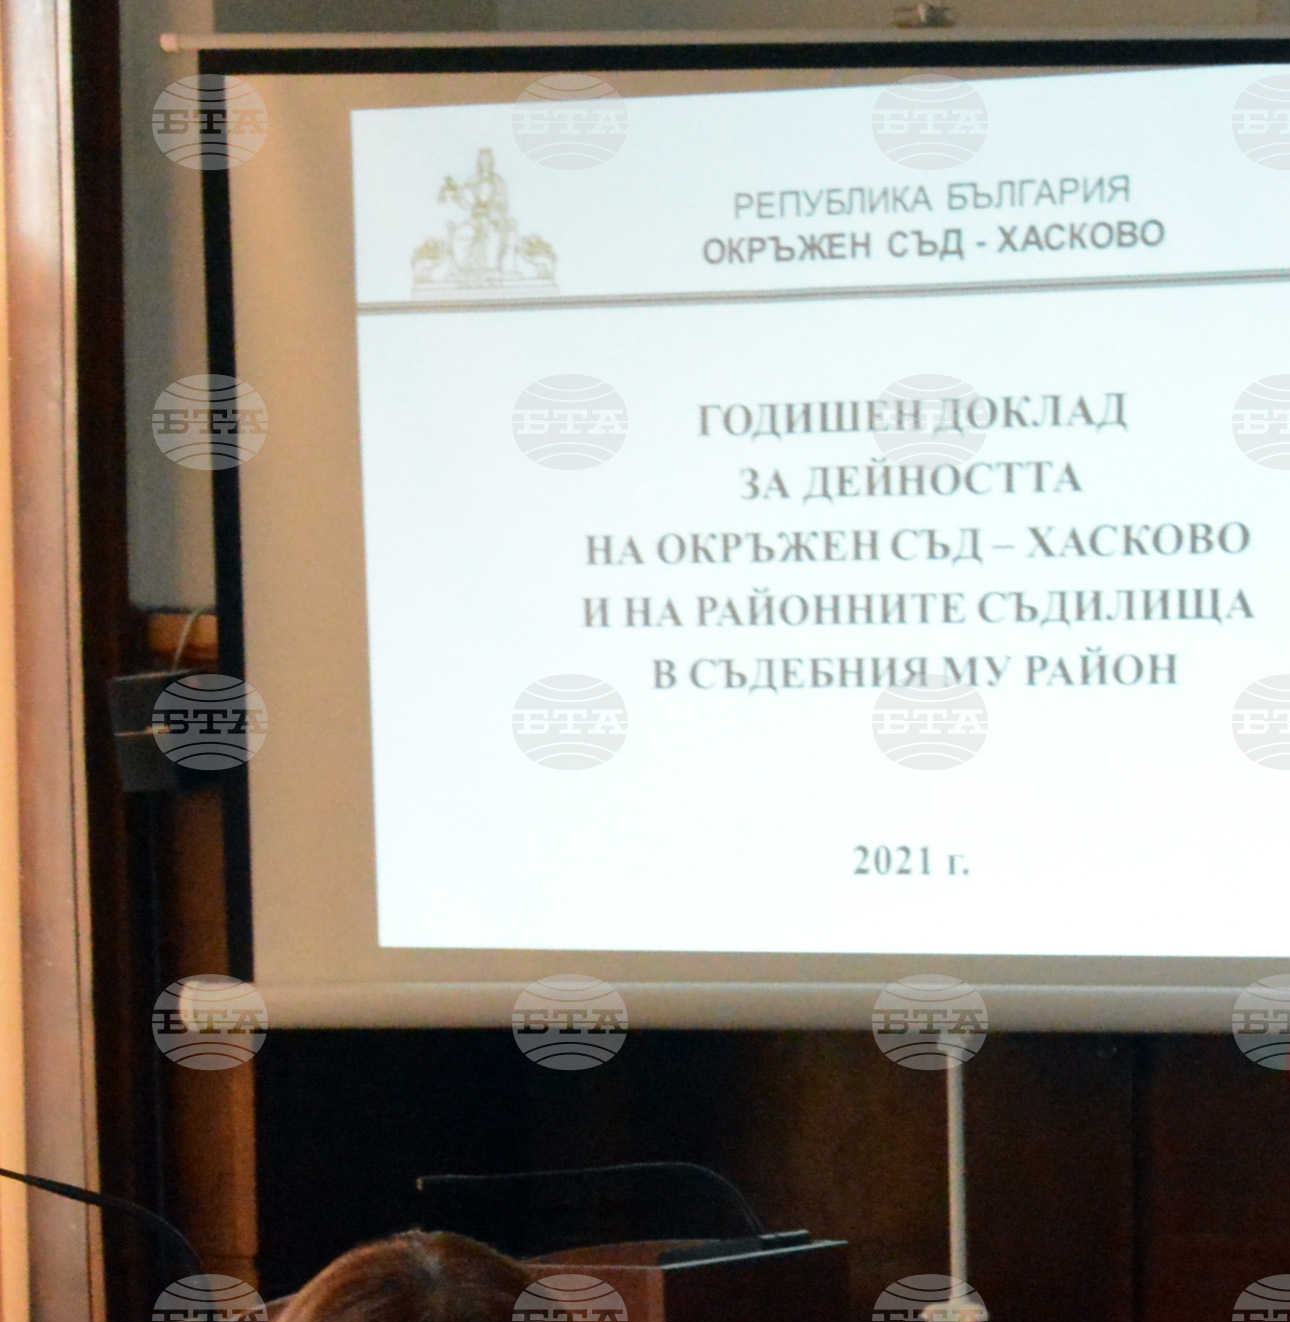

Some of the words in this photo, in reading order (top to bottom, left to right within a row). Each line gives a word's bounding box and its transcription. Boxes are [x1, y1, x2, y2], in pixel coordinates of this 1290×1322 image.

[733, 185, 932, 219] РЕПУБЛИКА
[946, 174, 1131, 210] БЪЛГАРИЯ
[703, 232, 872, 265] ОКРЪЖЕН
[887, 228, 965, 261] СЪД
[997, 219, 1167, 253] ХАСКОВО
[698, 398, 923, 442] ГОДИШЕН
[933, 391, 1129, 435] ДОКЛАД
[739, 467, 790, 501] ЗА
[802, 457, 1084, 504] ДЕЙНОСТТА
[585, 534, 646, 567] НА
[656, 528, 881, 566] ОКРЪЖЕН
[890, 526, 985, 566] СЪД
[1026, 519, 1253, 560] ХАСКОВО
[582, 596, 611, 629] И
[624, 595, 684, 628] НА
[695, 586, 967, 627] РАЙОННИТЕ
[977, 588, 1256, 626] СЪДИЛИЩА
[652, 659, 677, 690] В
[688, 656, 931, 695] СЪДЕБНИЯ
[941, 655, 1012, 688] МУ
[1025, 646, 1180, 688] РАЙОН
[852, 844, 933, 877] 2021
[947, 853, 971, 877] г.
